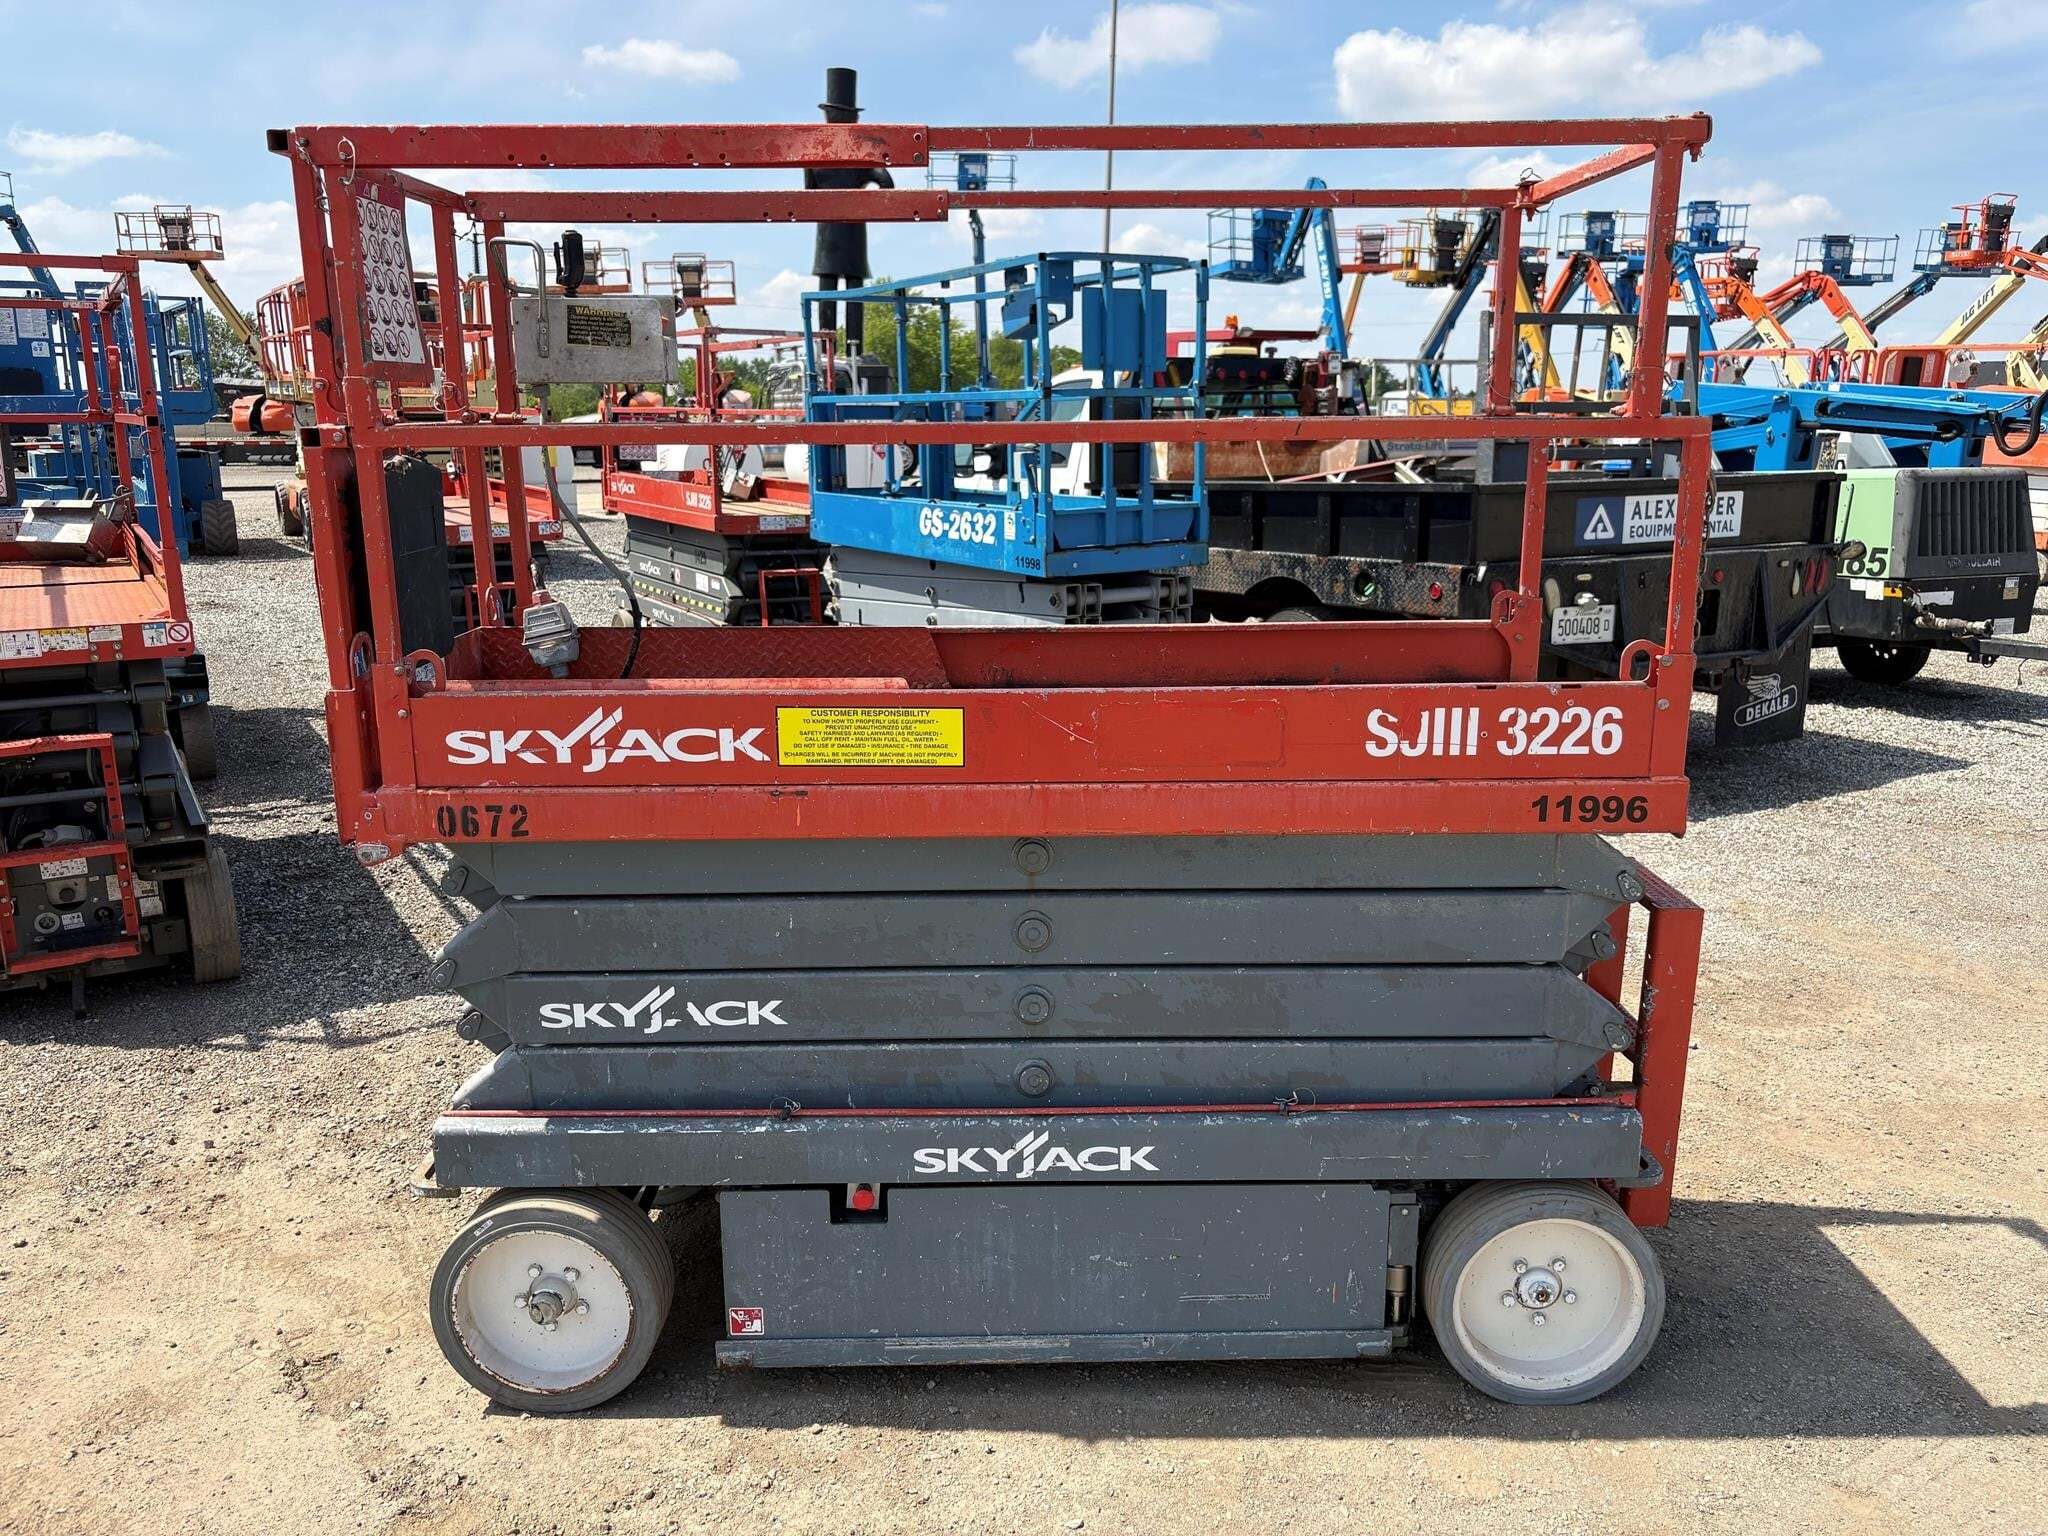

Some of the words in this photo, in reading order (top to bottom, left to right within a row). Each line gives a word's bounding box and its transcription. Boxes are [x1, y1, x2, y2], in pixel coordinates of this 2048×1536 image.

[1960, 305, 1975, 326] JLG
[1977, 284, 1996, 310] LIFT
[919, 506, 997, 545] GS-2632
[1015, 555, 1041, 571] 11998
[1558, 617, 1600, 637] 500408
[1745, 693, 1790, 722] DEKALB
[445, 706, 771, 773] SKYJACK
[1496, 706, 1624, 756] 3226
[437, 804, 529, 838] 0672
[1531, 795, 1649, 823] 11996
[539, 985, 789, 1034] SKYJACK
[913, 1130, 1161, 1179] SKYJACK
